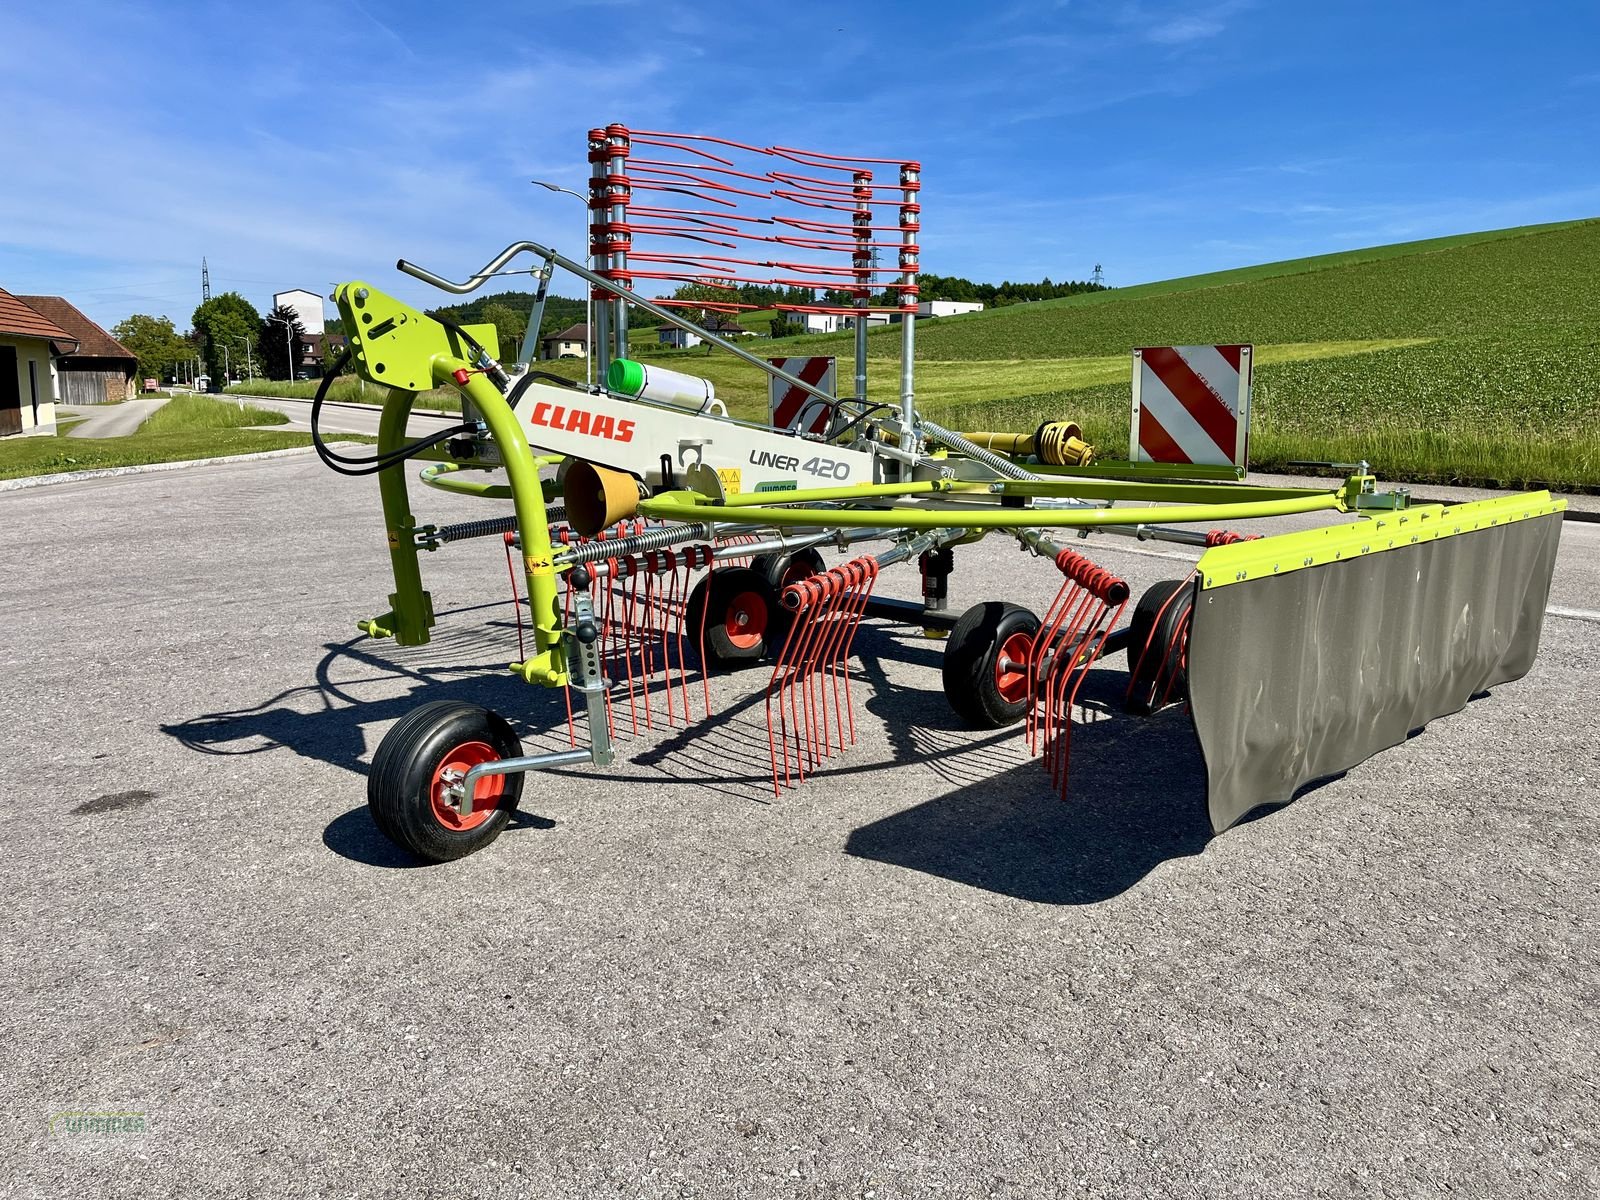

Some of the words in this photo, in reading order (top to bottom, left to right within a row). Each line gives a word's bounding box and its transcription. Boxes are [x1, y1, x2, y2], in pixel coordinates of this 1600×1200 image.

[531, 402, 635, 443] CLAAS
[749, 449, 799, 472] LINER
[802, 456, 850, 480] 420
